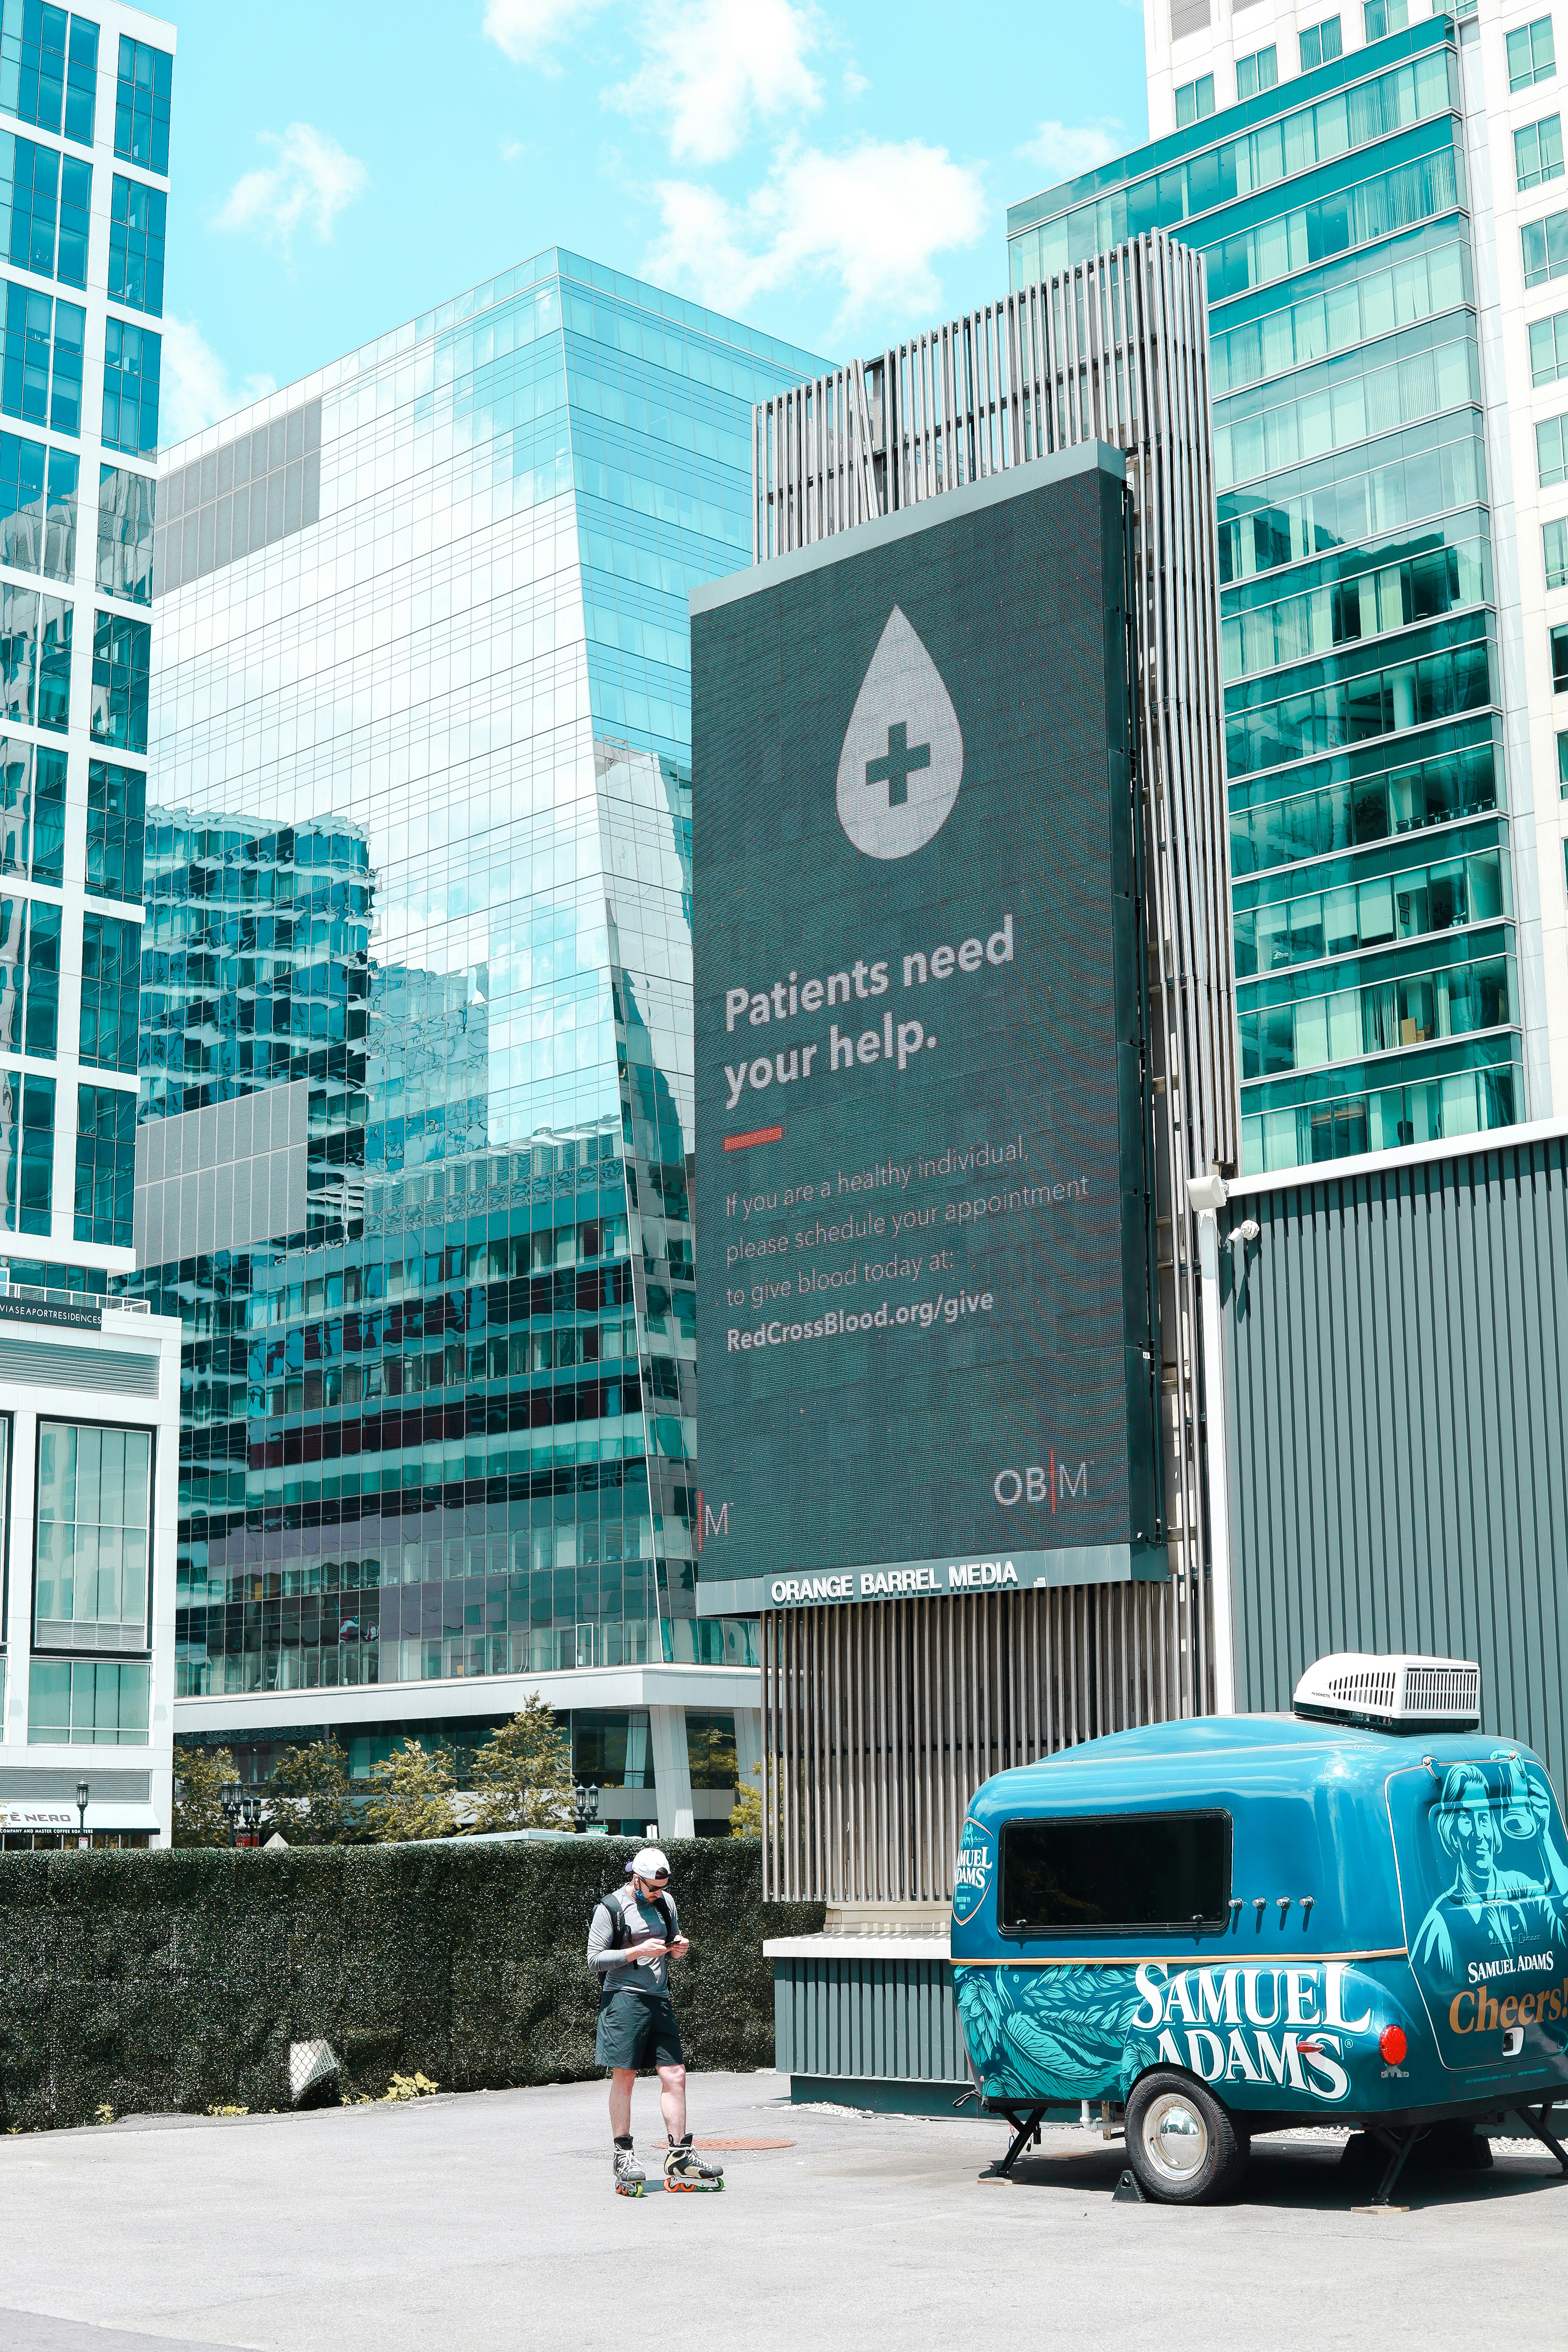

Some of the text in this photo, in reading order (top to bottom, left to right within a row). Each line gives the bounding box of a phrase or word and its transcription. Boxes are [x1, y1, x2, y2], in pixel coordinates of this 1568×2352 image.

[725, 914, 1014, 1031] Patients need
[724, 1011, 937, 1109] your help.
[726, 1135, 1029, 1221] If you are a healthy individual,
[726, 1176, 1090, 1268] please schedule your appointment
[726, 1250, 954, 1309] to give blood today at:
[727, 1292, 993, 1352] RedCrossBlood.org/give
[771, 1560, 1018, 1601] ORANGE BARREL MEDIA
[1132, 1962, 1371, 2032] SAMUEL
[1468, 1951, 1554, 1983] SAMUEL ADAMS
[1449, 1978, 1568, 2034] Cheers!
[1157, 2028, 1348, 2099] ADAMS
